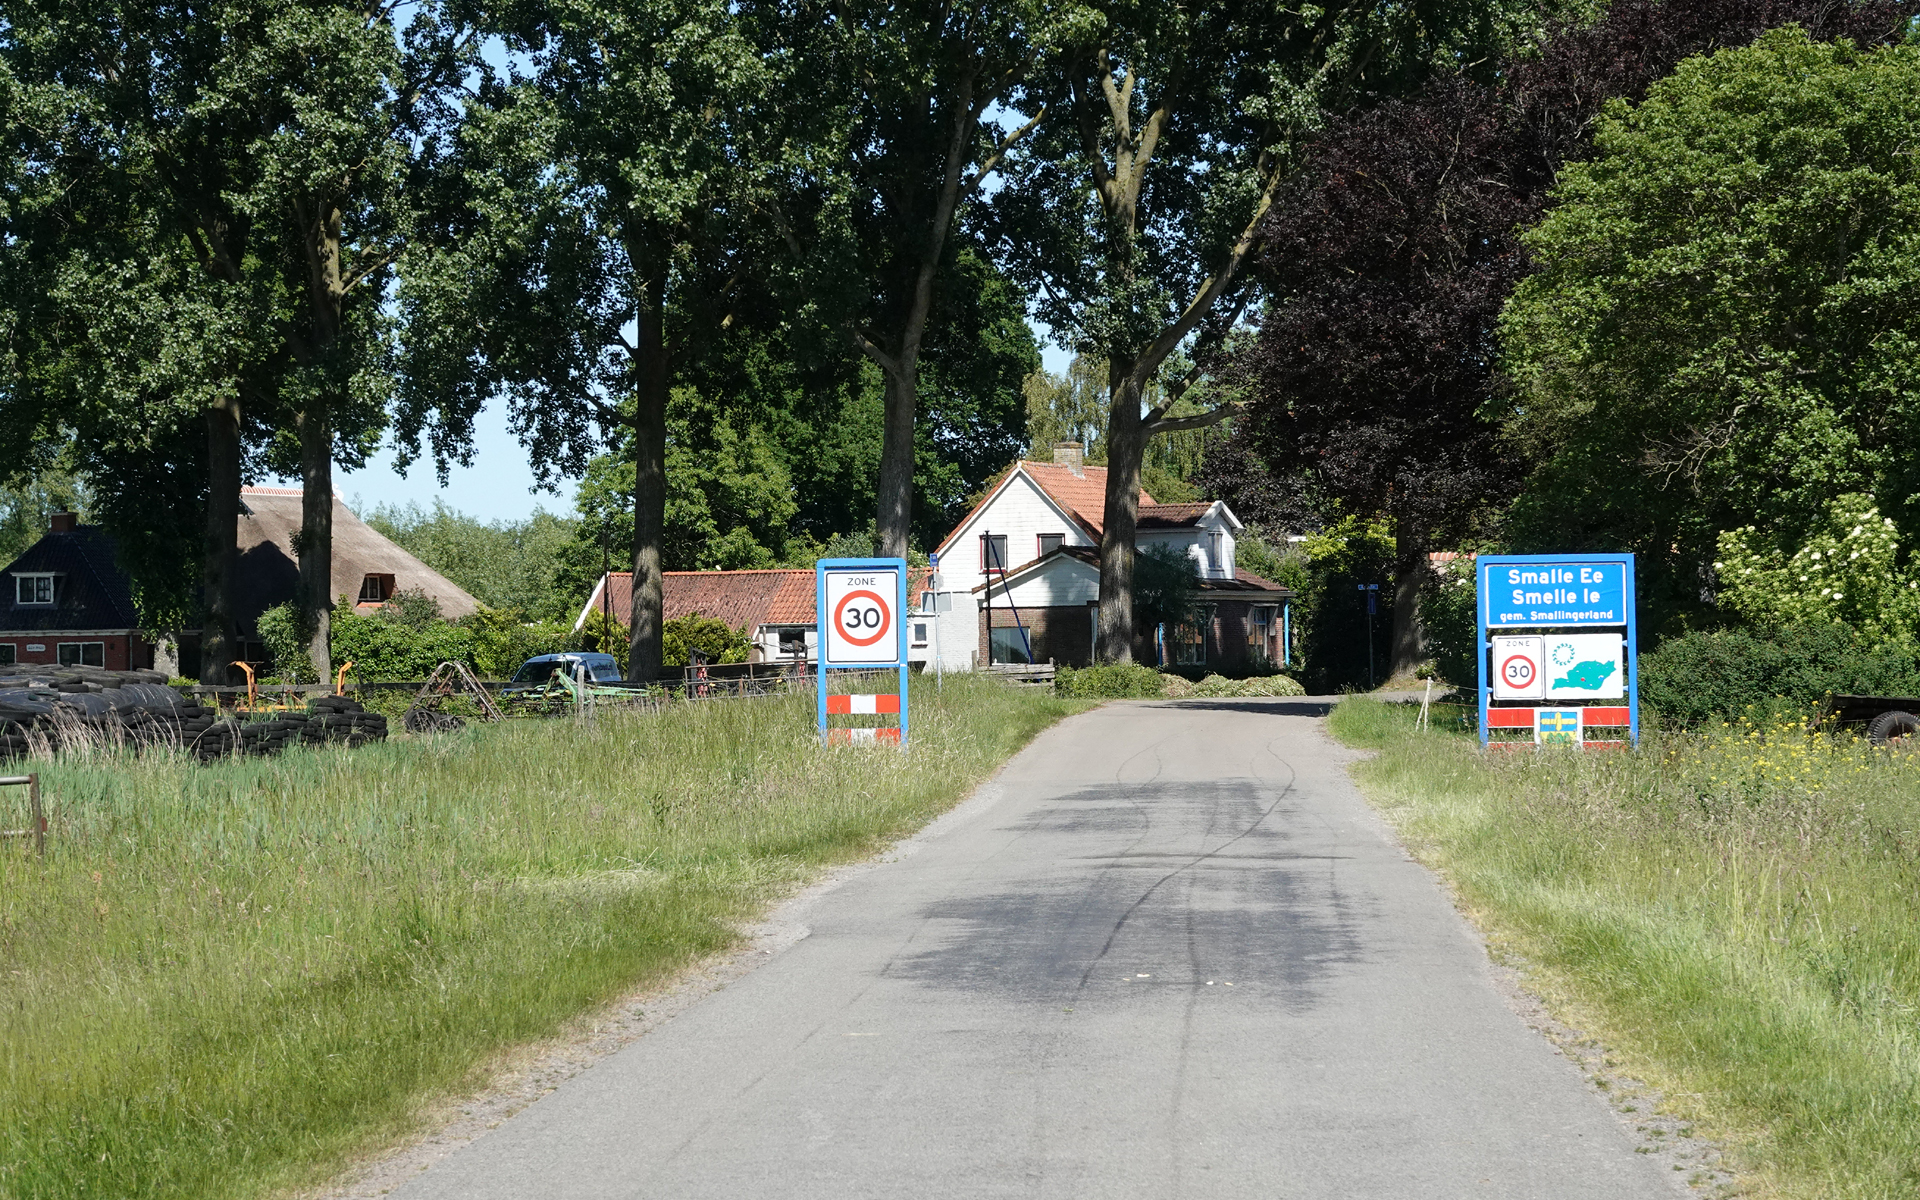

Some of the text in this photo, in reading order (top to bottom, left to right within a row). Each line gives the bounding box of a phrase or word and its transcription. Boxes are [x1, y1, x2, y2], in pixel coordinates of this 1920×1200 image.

[847, 577, 876, 586] ZONE
[1508, 568, 1604, 585] Smalle Ee
[1512, 588, 1601, 605] Smelle Ie
[846, 607, 881, 629] 30
[1499, 610, 1613, 623] gem. Smallingerland
[1508, 665, 1530, 678] 30
